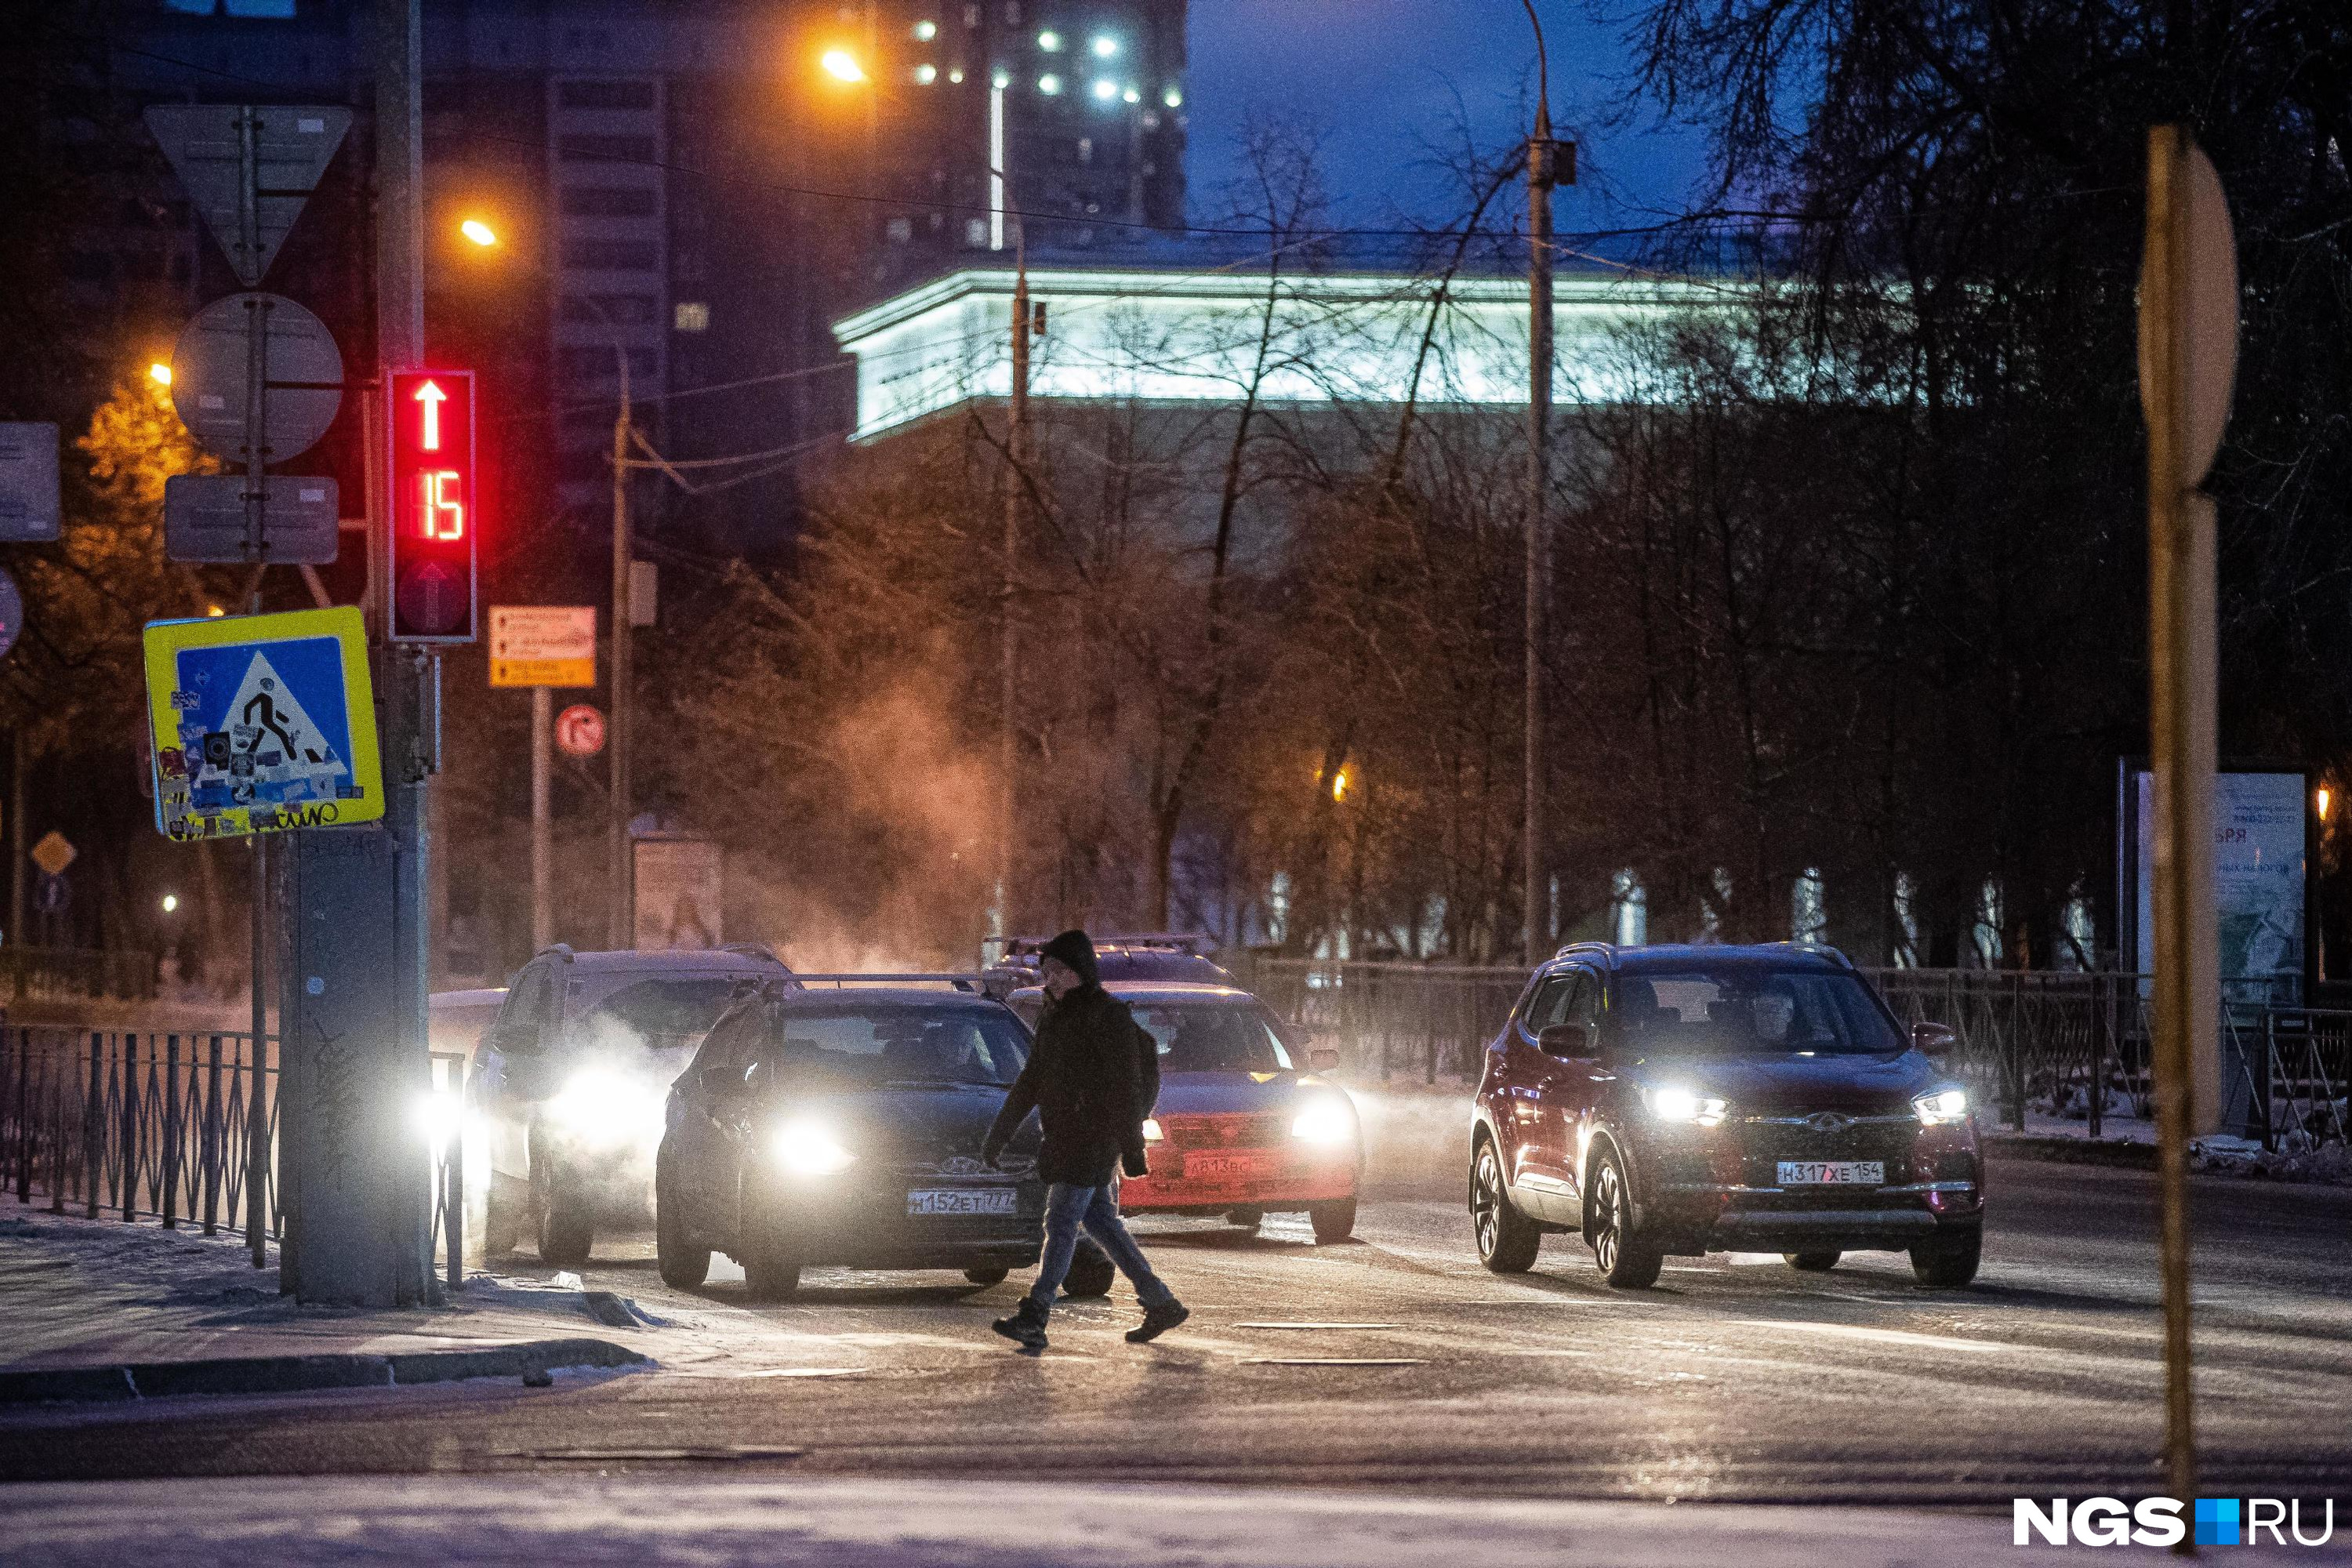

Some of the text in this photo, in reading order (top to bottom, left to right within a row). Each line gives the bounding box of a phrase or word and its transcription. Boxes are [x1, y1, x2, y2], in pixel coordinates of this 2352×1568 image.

[426, 470, 463, 540] 15
[1783, 1163, 1879, 1181] Н317ХЕ 154
